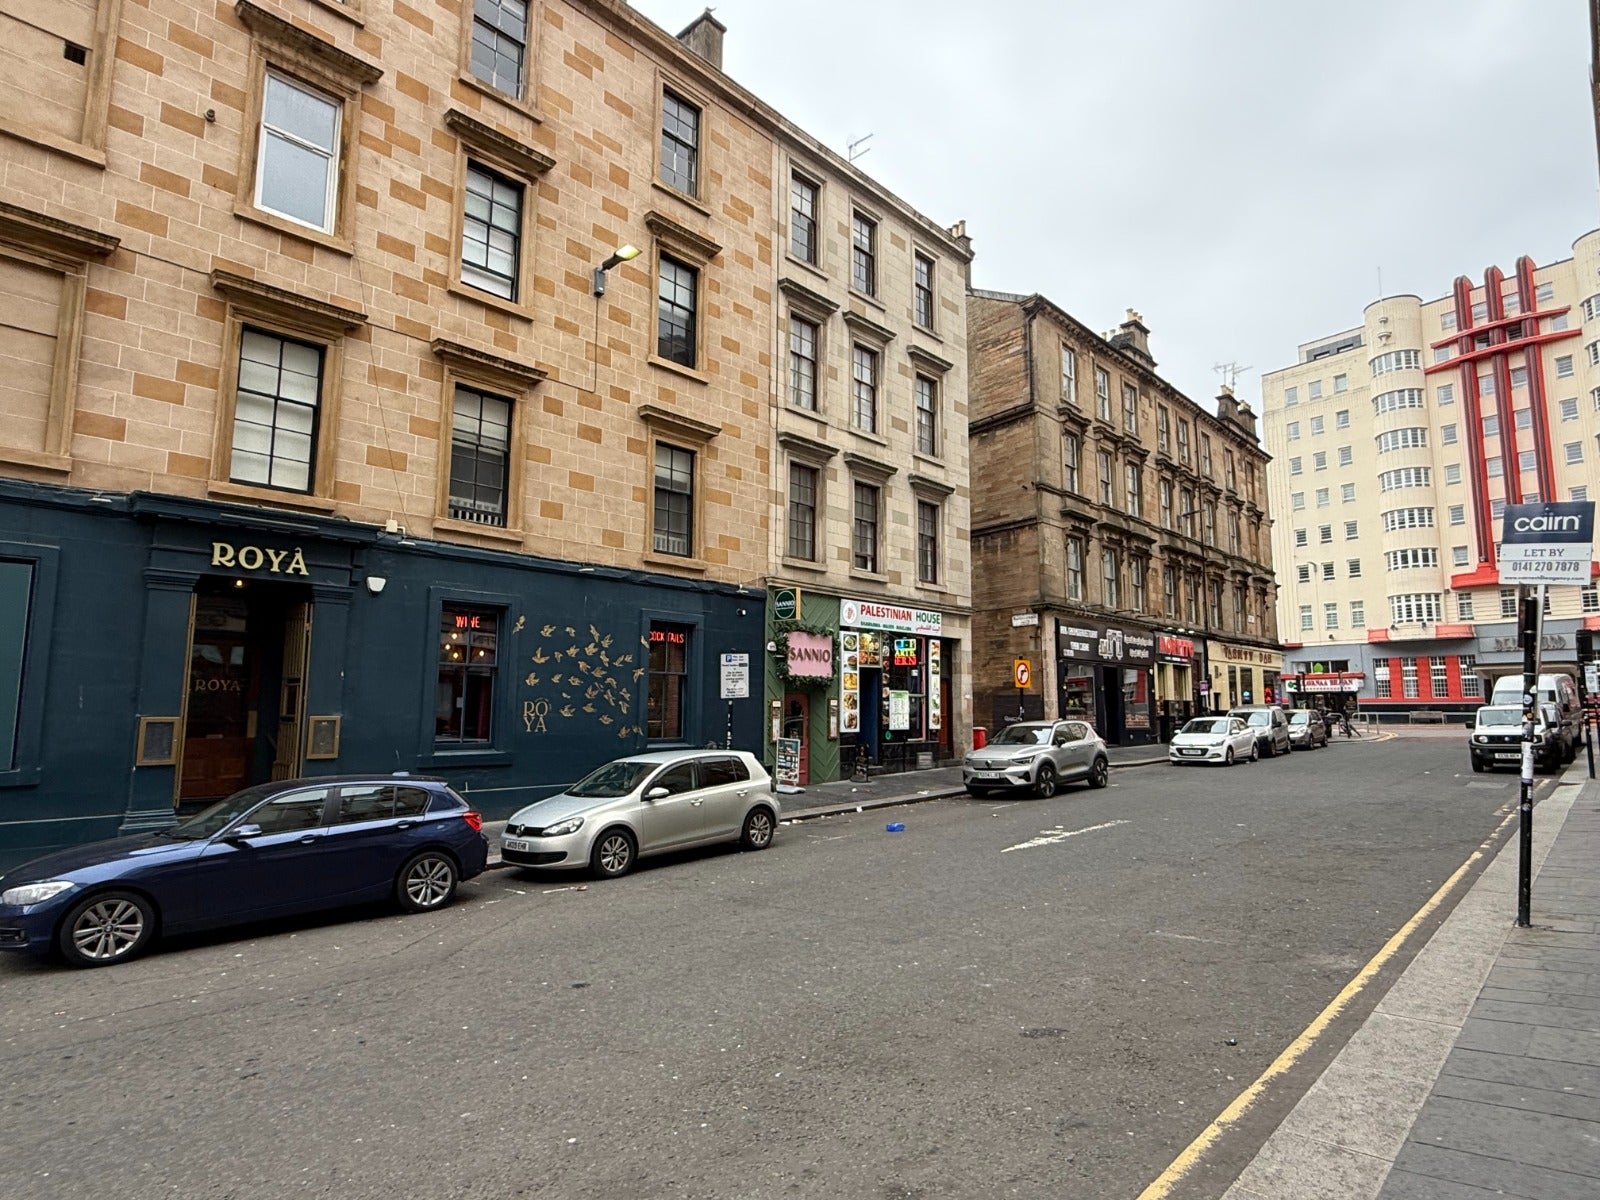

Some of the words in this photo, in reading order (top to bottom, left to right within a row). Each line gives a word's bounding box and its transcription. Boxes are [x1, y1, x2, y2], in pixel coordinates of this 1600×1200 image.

[1514, 513, 1579, 531] cairn
[1524, 549, 1546, 557] LET
[1549, 549, 1565, 557] BY
[1512, 562, 1532, 571] 0141
[1535, 562, 1552, 571] 270
[1555, 562, 1579, 571] 7878
[860, 605, 912, 621] PALESTINIAN
[916, 612, 941, 624] HOUSE
[789, 647, 831, 663] SANNIO
[195, 679, 241, 691] ROYA
